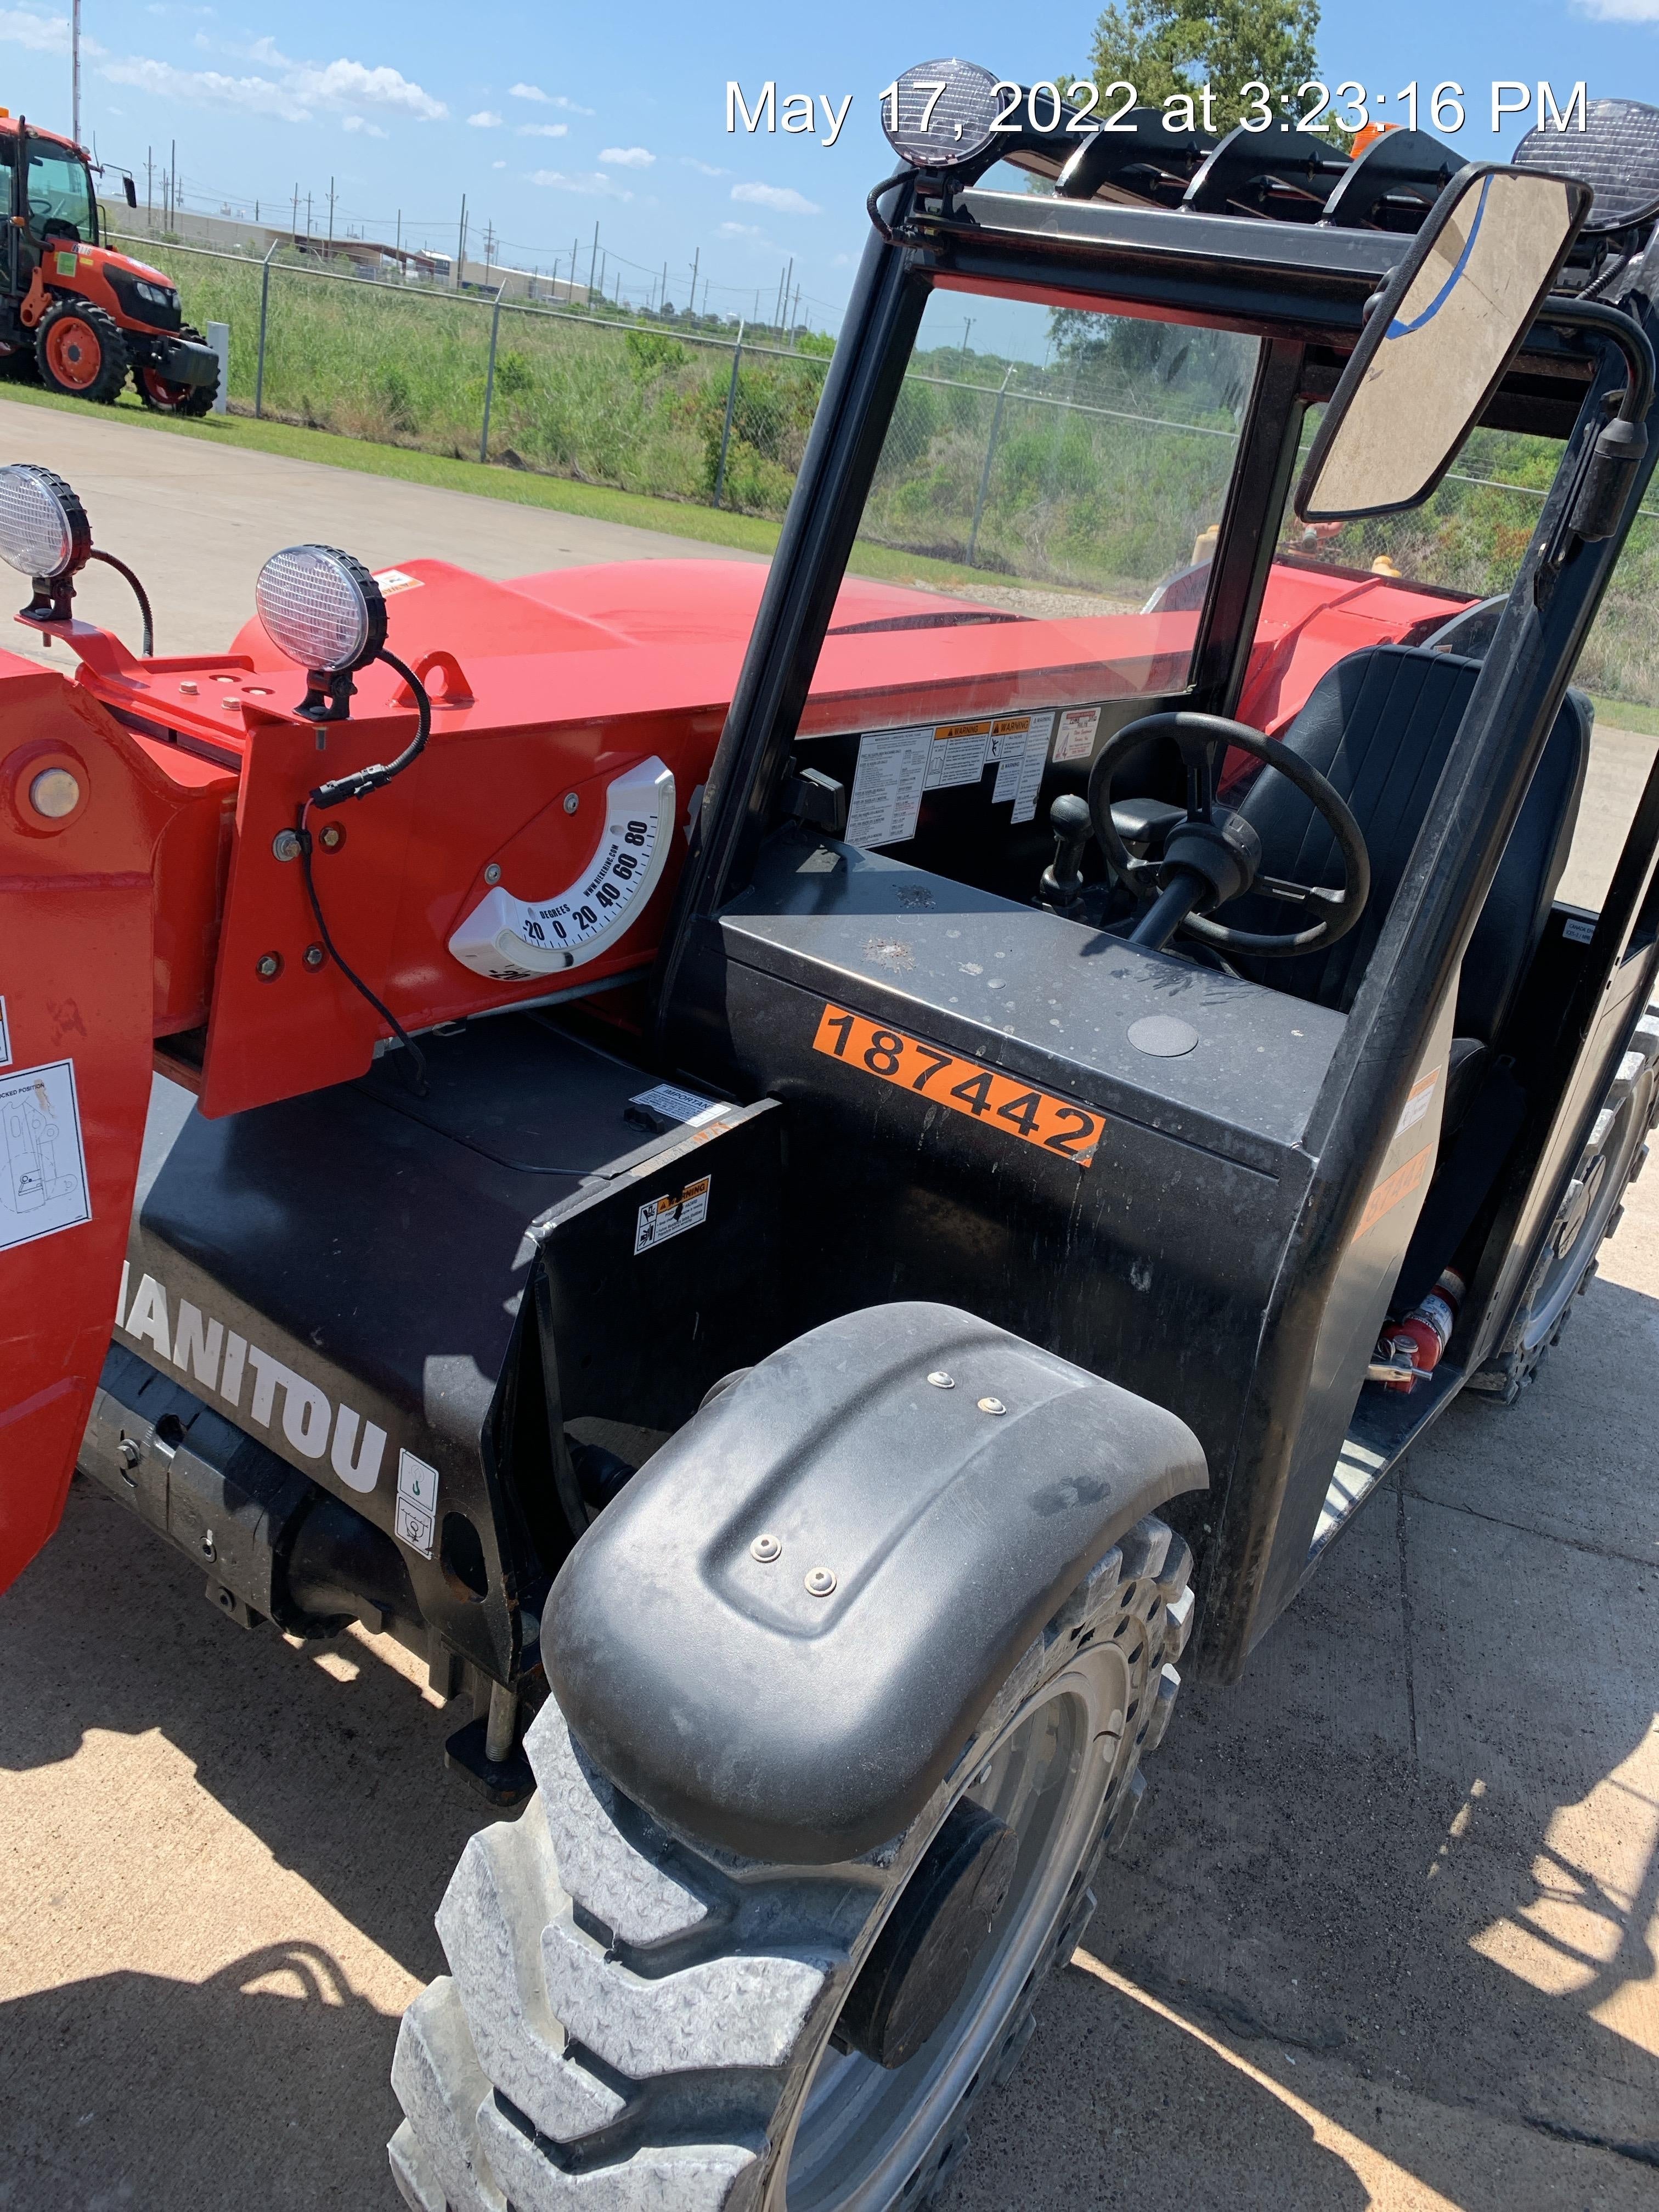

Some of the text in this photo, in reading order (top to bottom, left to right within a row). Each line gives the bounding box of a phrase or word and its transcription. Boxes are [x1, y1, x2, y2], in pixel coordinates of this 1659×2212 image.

[954, 725, 979, 736] WARNING
[1001, 720, 1029, 732] WARNING
[583, 844, 619, 897] WWW.RIEKERINC.COM
[523, 820, 647, 940] -20 0 20 40 60 80
[540, 904, 571, 919] DEGREES
[1568, 923, 1586, 932] CANADA
[18, 1083, 45, 1093] POSITION
[827, 1015, 1096, 1156] 187442
[663, 1089, 713, 1109] IMPORTAN
